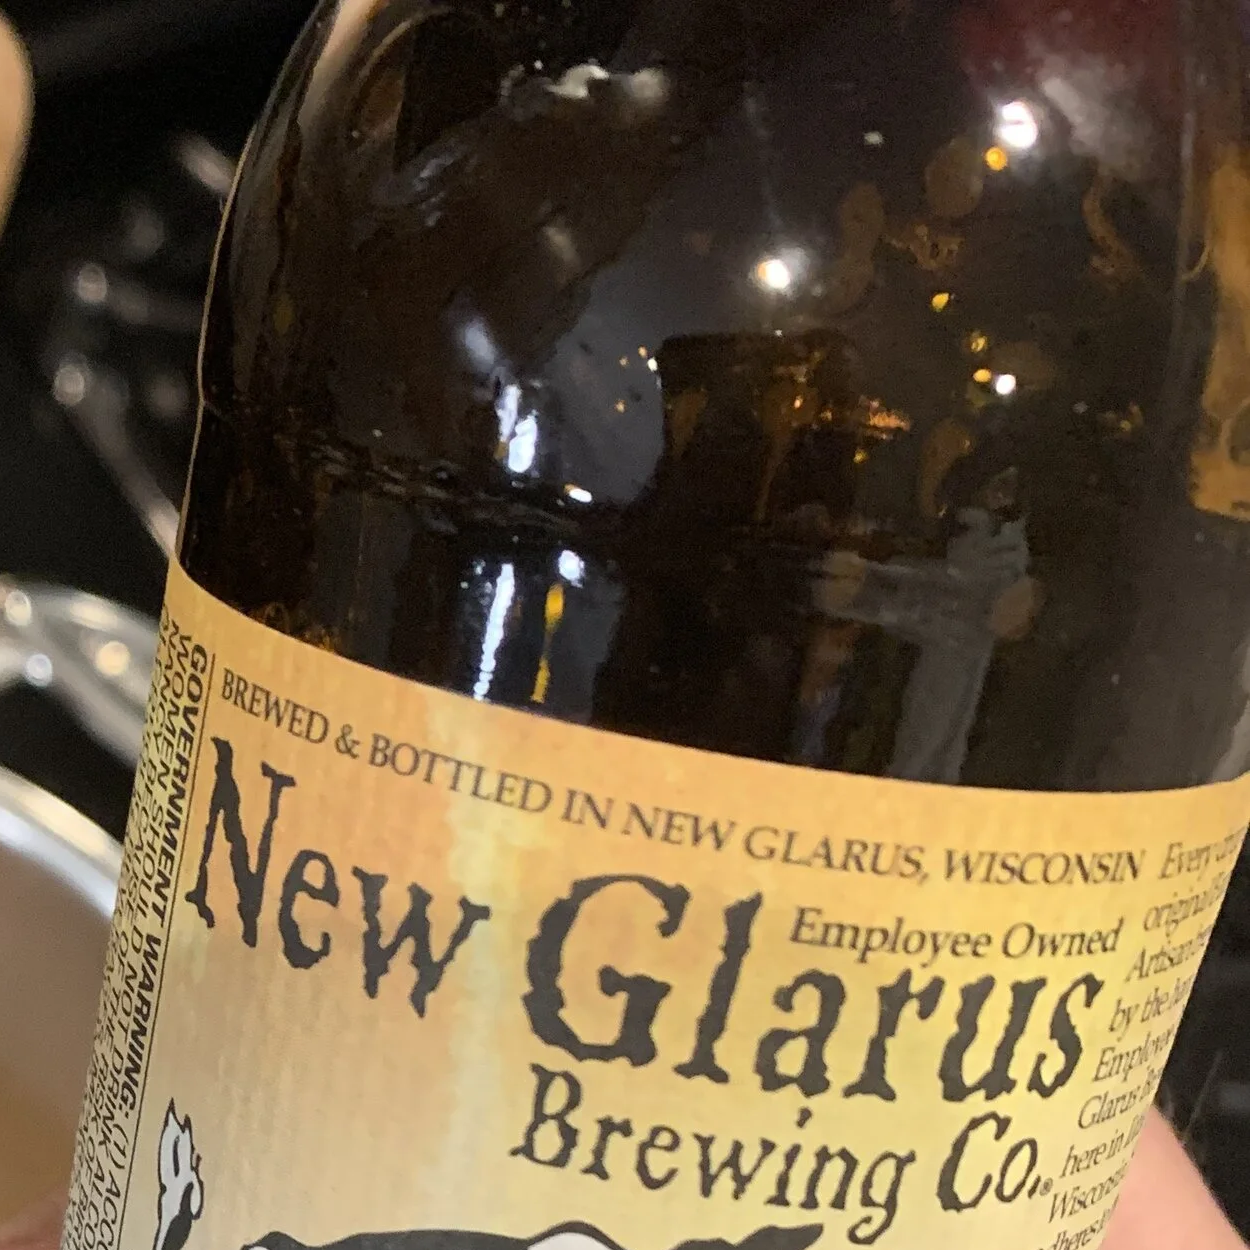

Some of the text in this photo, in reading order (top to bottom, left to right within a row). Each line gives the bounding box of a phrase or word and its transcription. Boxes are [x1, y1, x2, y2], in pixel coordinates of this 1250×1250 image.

[155, 634, 192, 791] WOMEN
[221, 668, 1146, 886] BREWED & BOTTLED IN NEW GLARUS, WISCONSIN
[151, 643, 206, 927] GOVERNMENT
[132, 798, 164, 954] SHOULD
[185, 736, 491, 1018] New
[521, 873, 1104, 1101] Glarus
[790, 907, 1125, 968] Employee Owned
[117, 960, 138, 1044] NOT
[118, 932, 162, 1119] WARNING:
[1109, 998, 1139, 1042] by
[97, 1045, 124, 1158] DRINK
[108, 1122, 129, 1169] (1)
[511, 1063, 915, 1245] Brewing
[1059, 1144, 1106, 1179] here
[1078, 1086, 1141, 1129] Glarus
